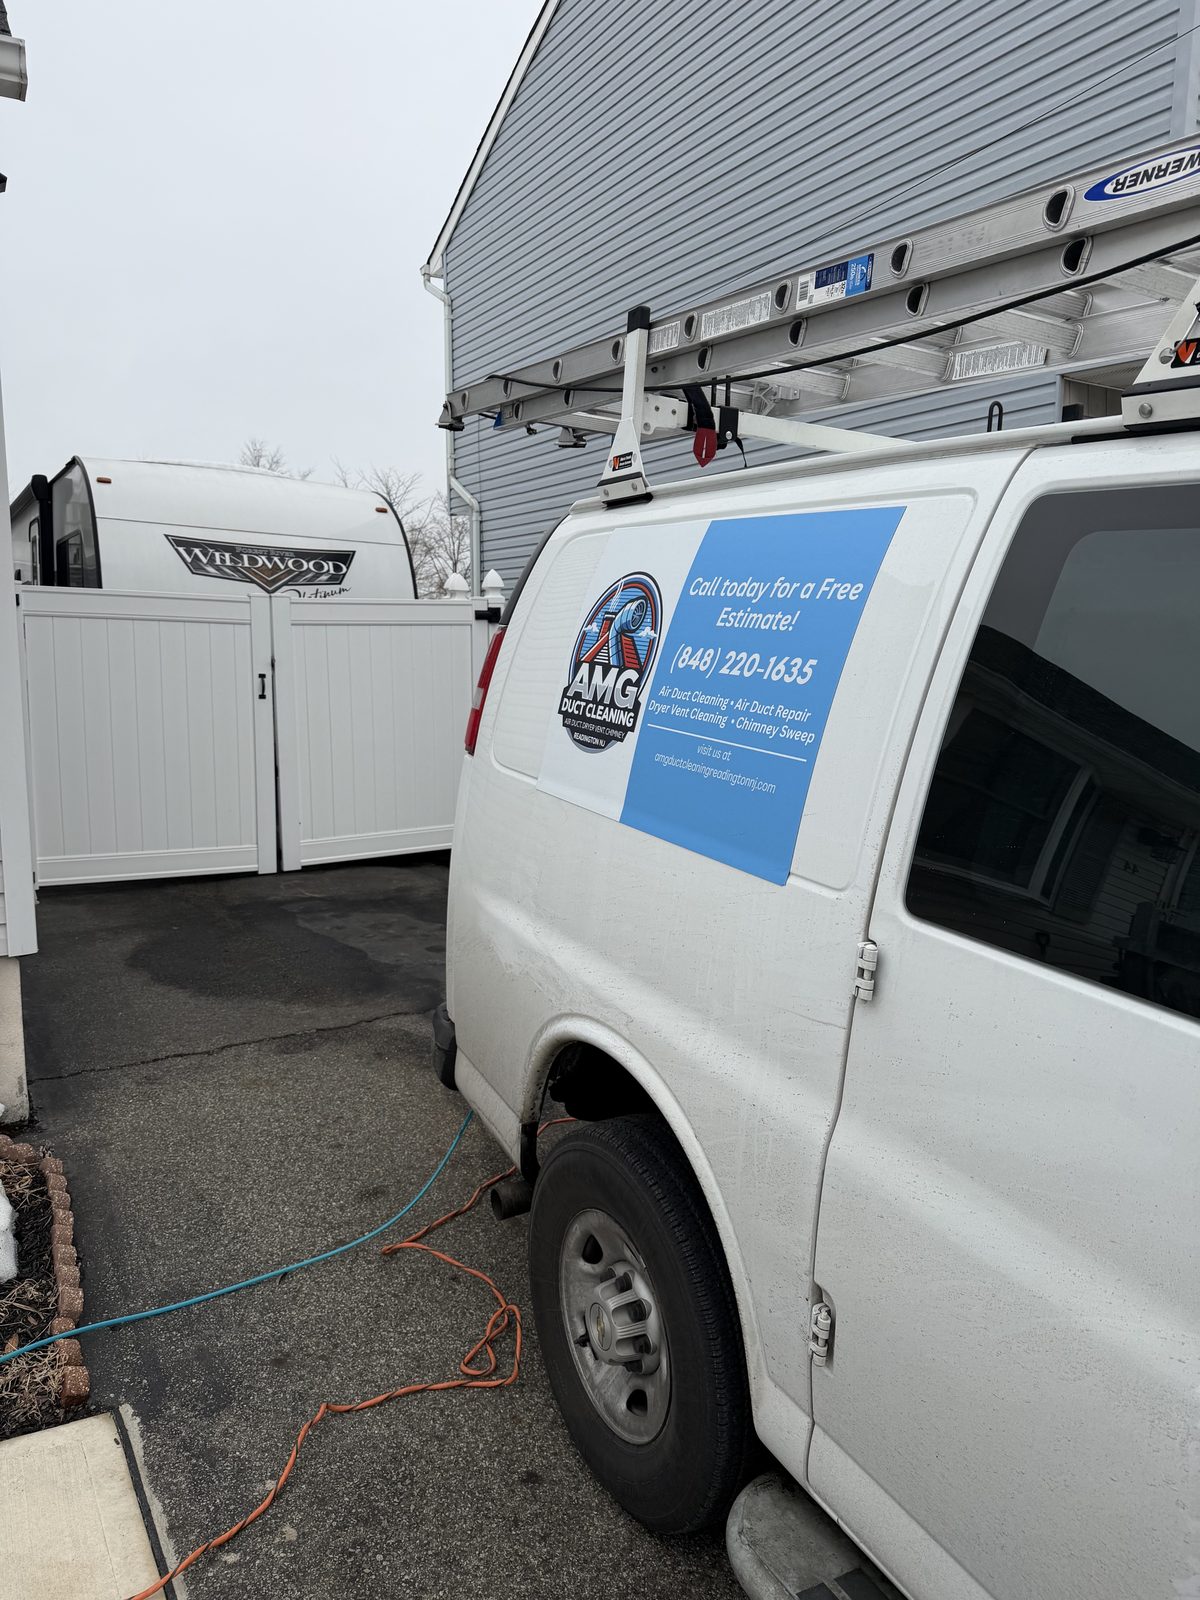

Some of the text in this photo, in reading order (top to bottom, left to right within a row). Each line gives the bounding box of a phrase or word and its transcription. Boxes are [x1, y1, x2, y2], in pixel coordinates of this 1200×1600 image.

[1112, 151, 1200, 193] WERNER
[175, 546, 348, 575] WILDWOOD
[689, 576, 864, 603] Call today for a Free
[716, 607, 801, 632] Estimate!
[670, 643, 818, 685] (848) 220-1635
[567, 662, 640, 709] AMG
[561, 697, 635, 727] DUCT CLEANING
[659, 685, 812, 723] Air Duct Cleaning Air Duct Repair
[648, 700, 816, 746] Dryer Vent Cleaning Chimney Sweep
[697, 743, 732, 761] visit us at
